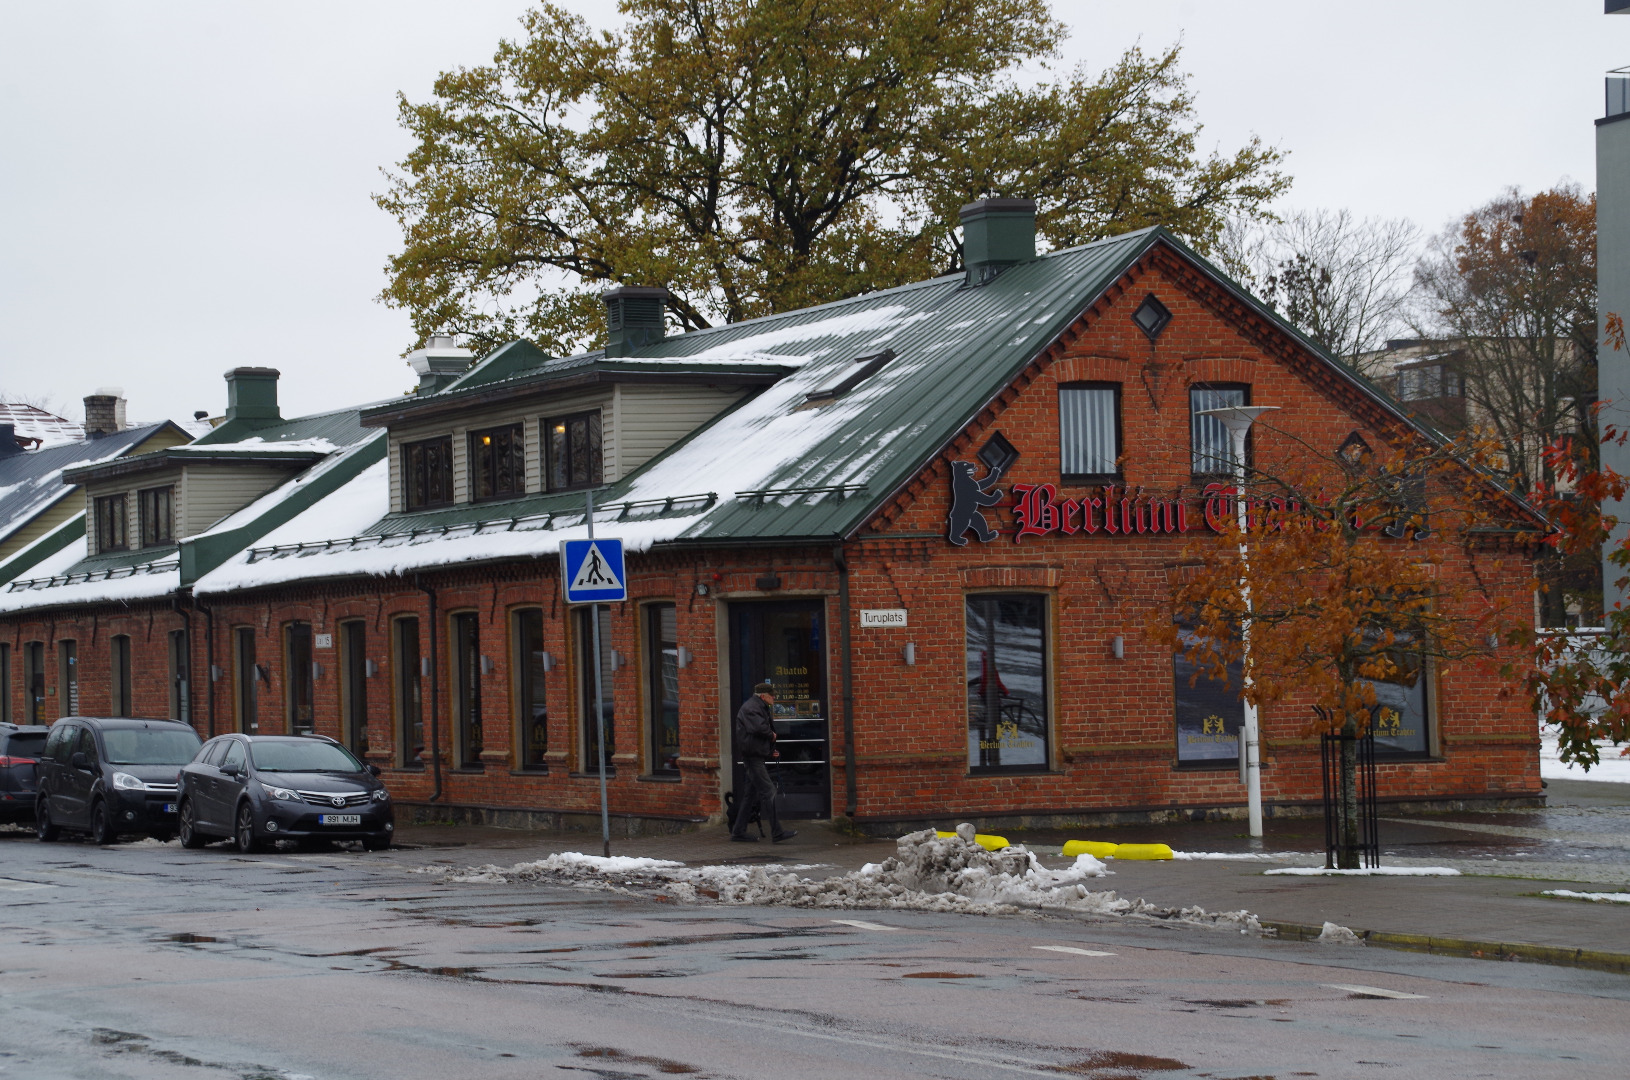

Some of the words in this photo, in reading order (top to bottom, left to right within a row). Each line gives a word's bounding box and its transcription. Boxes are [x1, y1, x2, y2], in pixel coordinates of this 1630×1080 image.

[864, 612, 903, 624] Turuplats
[775, 666, 808, 676] Avatud
[327, 815, 339, 823] 991
